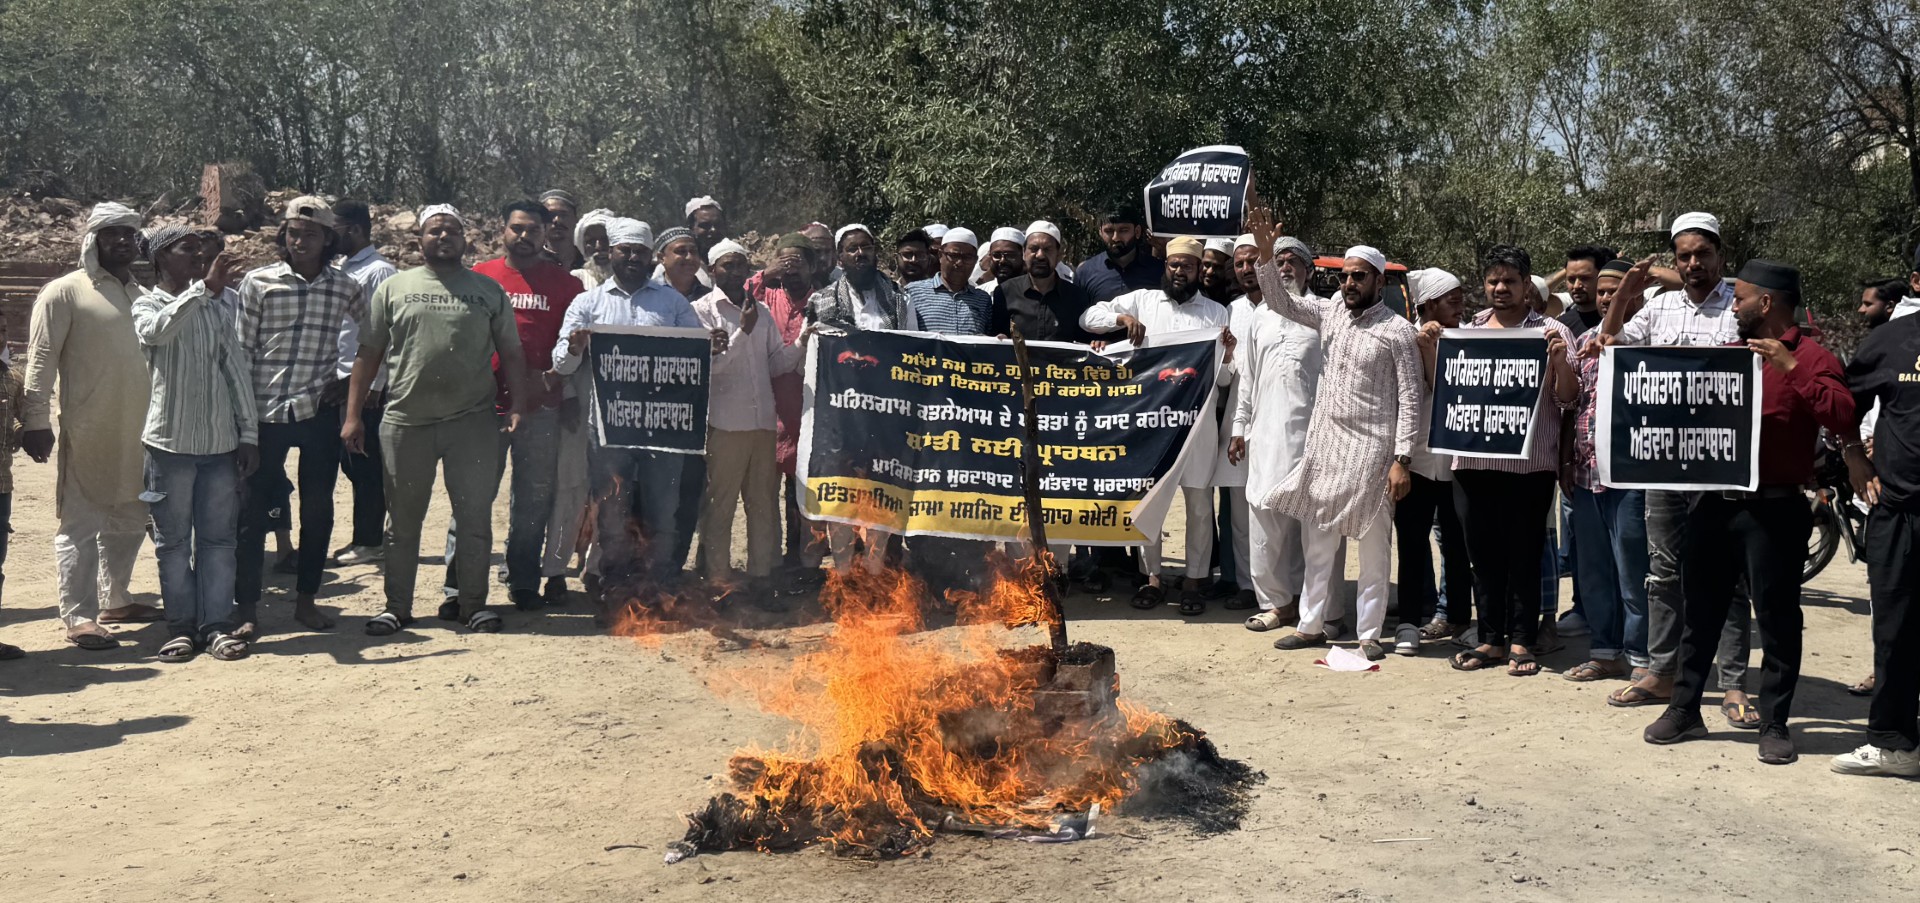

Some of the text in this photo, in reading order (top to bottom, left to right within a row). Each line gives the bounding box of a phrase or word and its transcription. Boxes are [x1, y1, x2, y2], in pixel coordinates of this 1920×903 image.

[1161, 187, 1190, 219] ਅੱਤਵਾਦ
[600, 344, 650, 383] ਪਾਕਿਸਤਾਨ
[890, 365, 944, 387] ਮਿਲੇਗਾ
[1021, 381, 1055, 396] ਹੀਂ
[942, 357, 966, 373] ਨਮ
[971, 362, 1000, 378] ਹਨ,
[1045, 363, 1077, 380] ਦਿਲ
[1444, 349, 1492, 386] ਪਾਕਿਸਤਾਨ
[1623, 360, 1744, 415] ਪਾਕਿਸਤਾਨ ਮੁਰਦਾਬਾਦ।
[606, 391, 642, 429] ਅੱਤਵਾਦ
[829, 387, 912, 416] ਪਹਿਲਗਾਮ
[999, 404, 1012, 428] ਦੇ
[1074, 410, 1088, 440] ਨੂੰ
[1094, 412, 1130, 430] ਯਾਦ
[1445, 394, 1482, 433] ਅੱਤਵਾਦ
[970, 437, 1023, 459] ਲਈ
[1630, 415, 1737, 471] ਅੱਤਵਾਦ ਮੁਰਦਾਬਾਦ।
[872, 458, 942, 483] ਪਾਕਿਸਤਾਨ
[946, 468, 1014, 489] ਮੁਰਦਾਬਾਦ
[1038, 473, 1088, 491] ਅੱਤਵਾਦ
[1009, 501, 1073, 525] ਈਗਾਹ
[1079, 502, 1118, 527] ਕਮੇਟੀ
